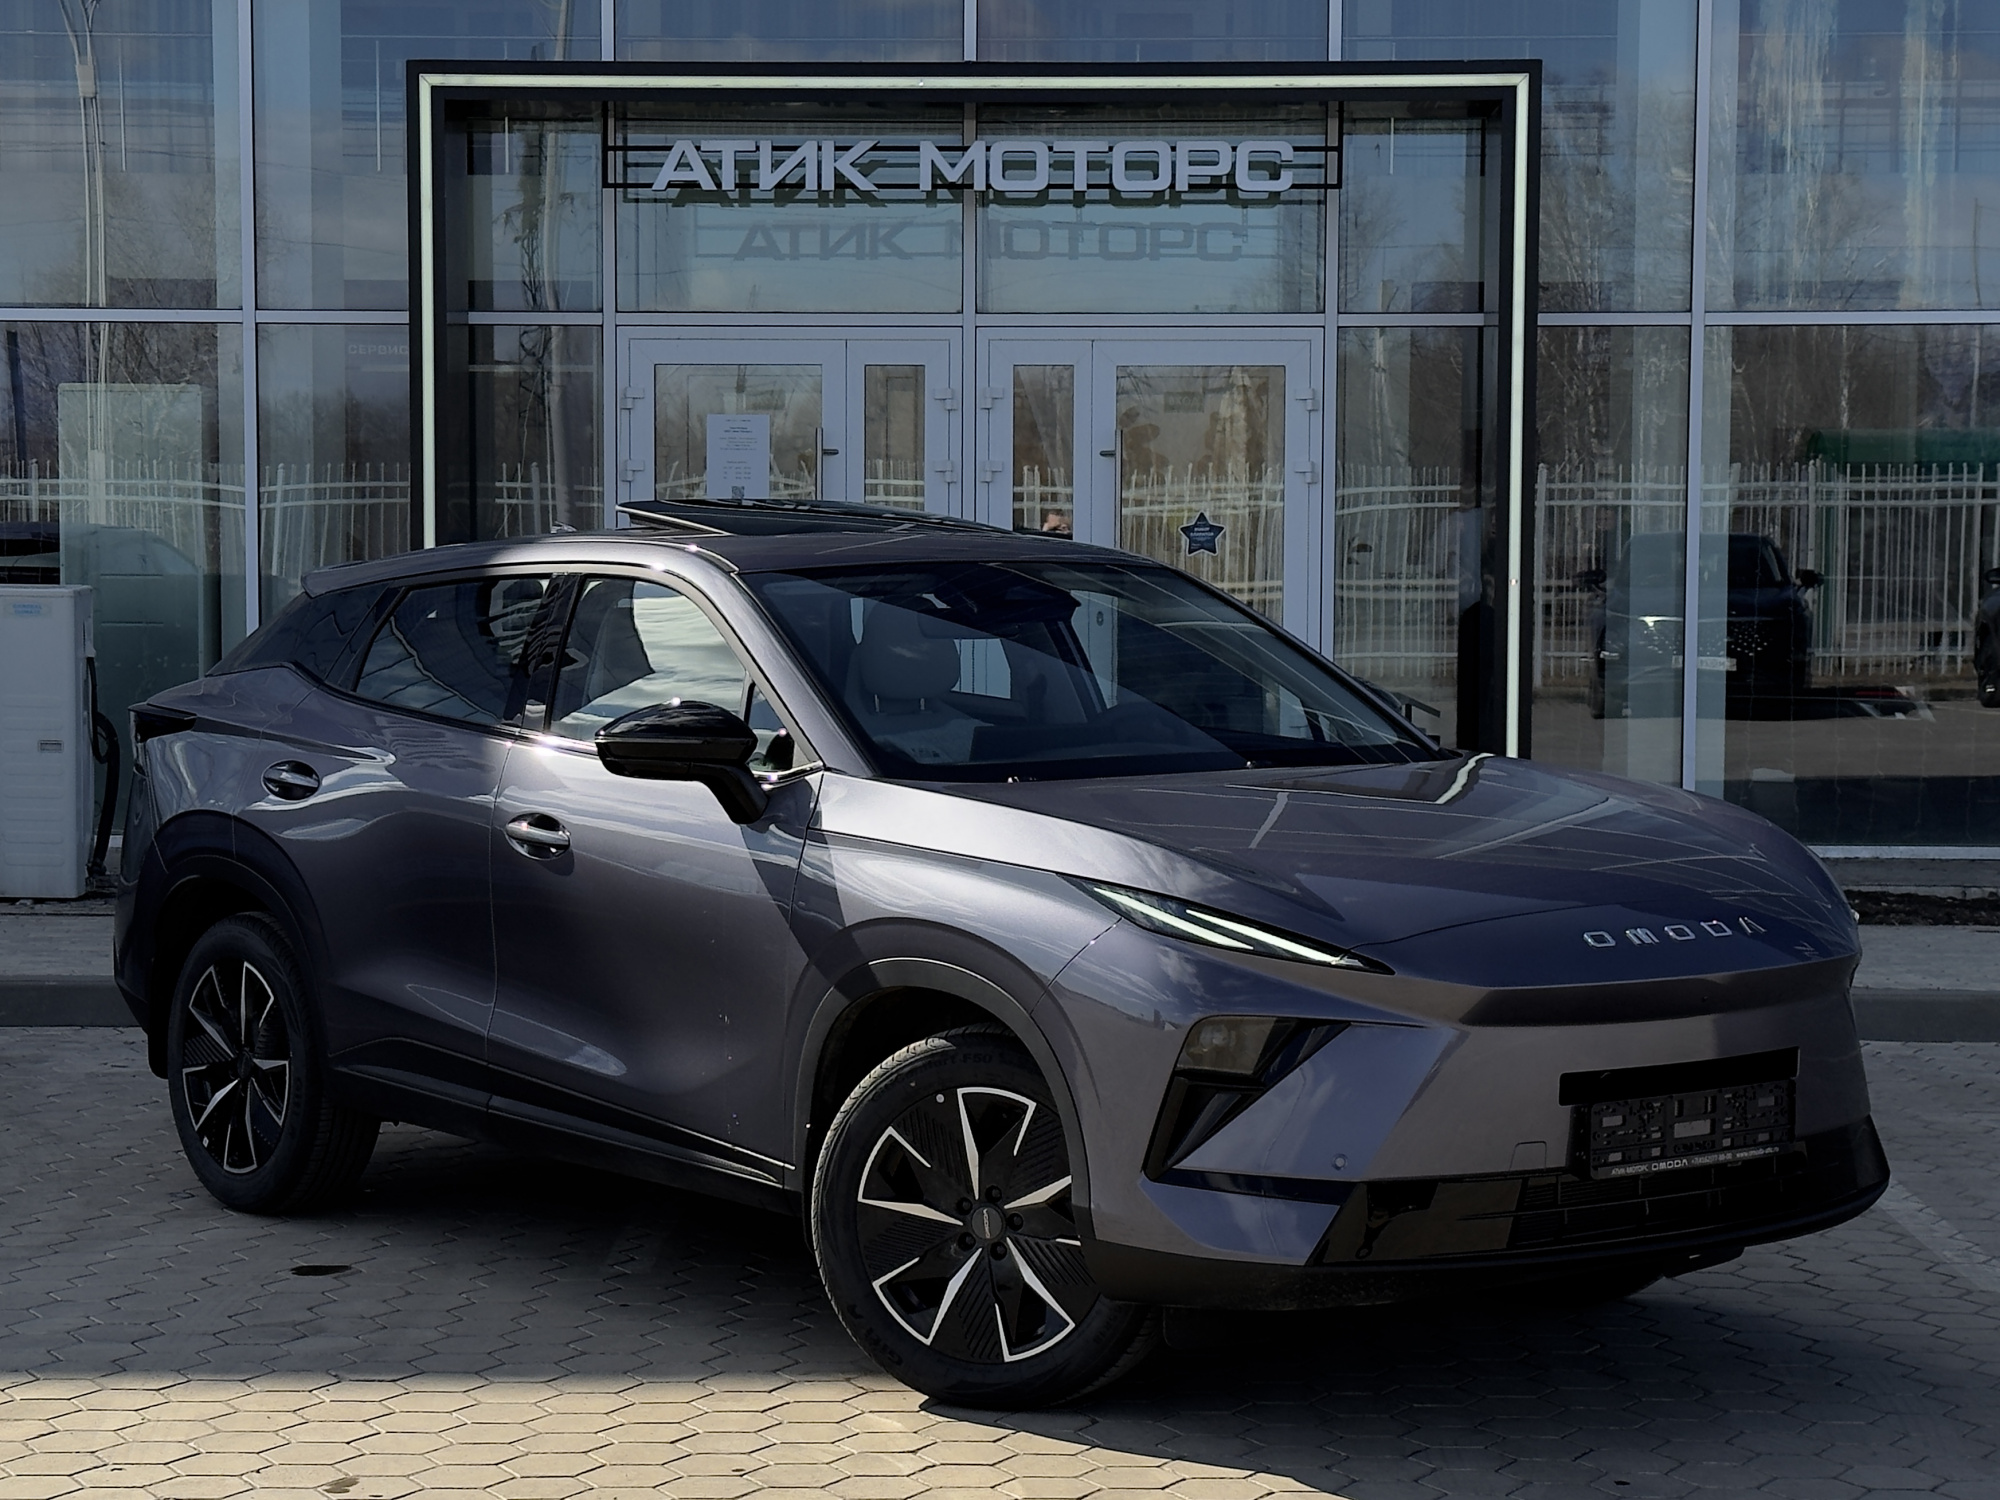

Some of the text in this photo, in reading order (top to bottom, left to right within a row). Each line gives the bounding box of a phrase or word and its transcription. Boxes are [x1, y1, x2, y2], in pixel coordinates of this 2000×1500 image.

[652, 139, 1295, 193] АТИК МОТОРС
[1582, 915, 1767, 948] OMODA
[1651, 1159, 1689, 1171] OMODA
